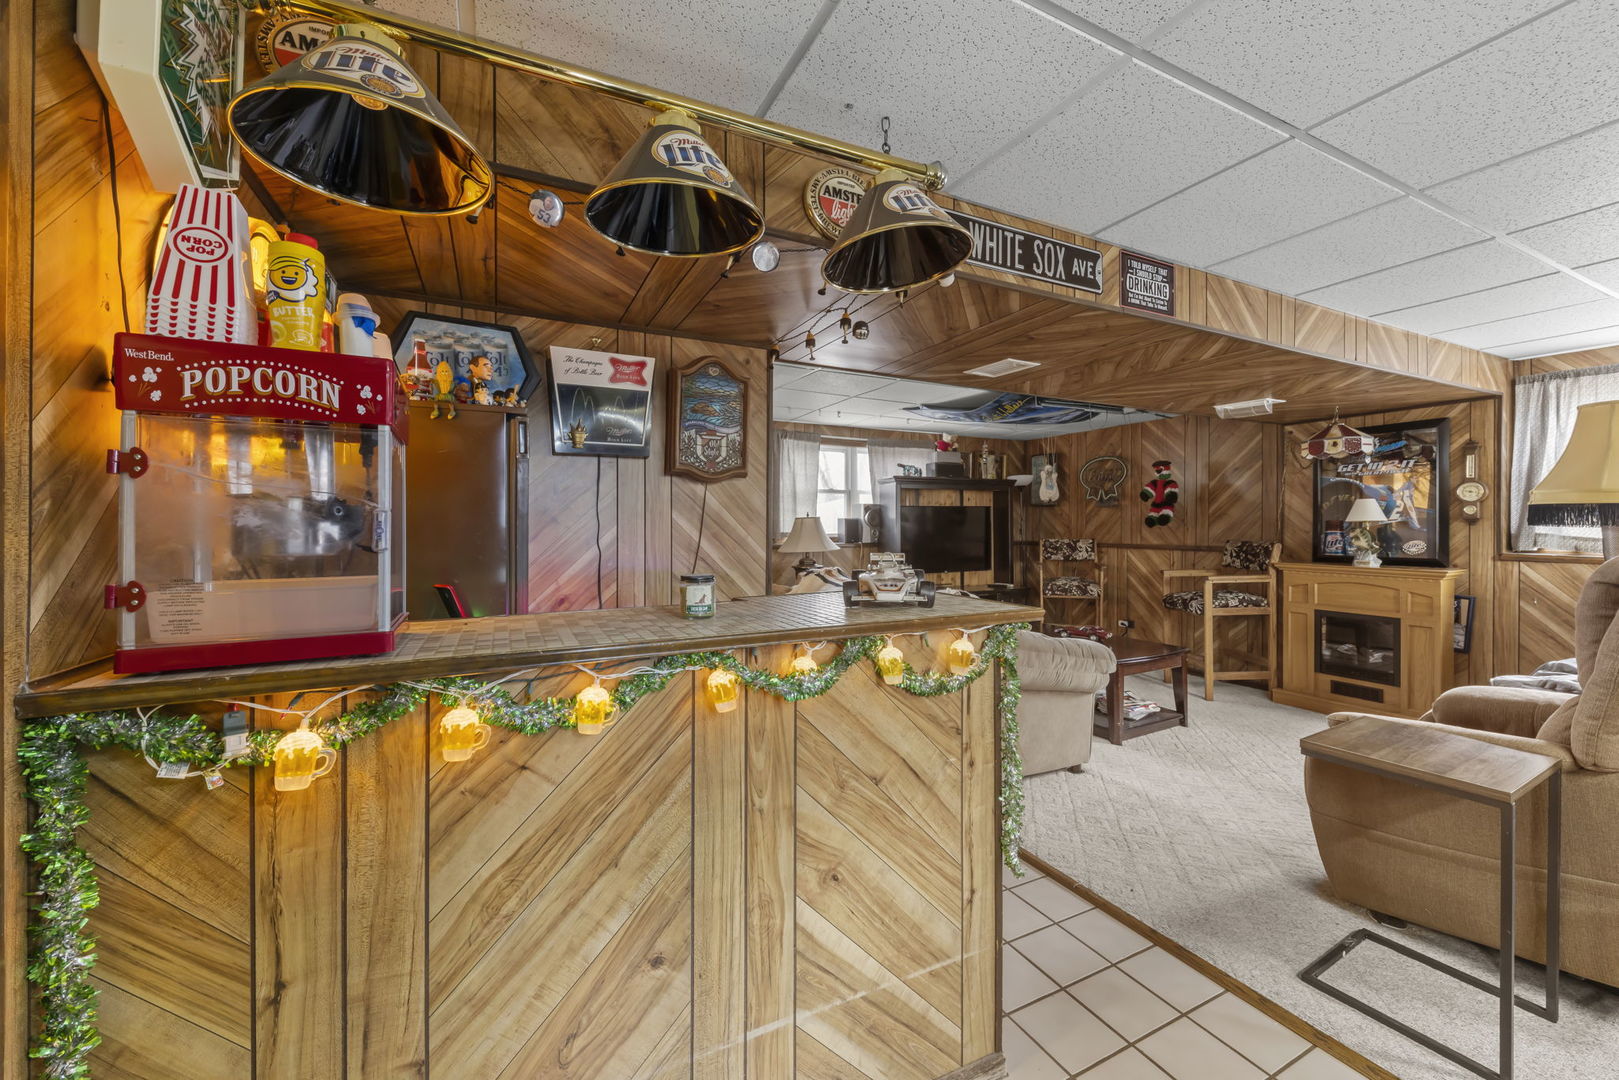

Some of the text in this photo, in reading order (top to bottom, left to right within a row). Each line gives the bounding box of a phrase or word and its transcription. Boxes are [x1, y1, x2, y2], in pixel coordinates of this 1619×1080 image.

[661, 143, 723, 171] Lite
[823, 185, 863, 205] AMSTE
[181, 234, 223, 249] CORN
[186, 243, 216, 256] POP
[969, 221, 1094, 280] WHITE SOX AVE
[1131, 260, 1141, 270] TOLD
[1142, 262, 1157, 273] MYSELF
[1158, 266, 1168, 276] THAT
[1136, 269, 1152, 280] SHOULD
[1153, 273, 1163, 282] STOP
[1128, 275, 1168, 299] DRINKING
[272, 305, 313, 317] BUTTER
[124, 348, 147, 359] West
[563, 355, 603, 367] The Champagne
[588, 368, 603, 376] Beer
[615, 364, 641, 373] Miller
[180, 366, 342, 411] POPCORN
[1338, 459, 1416, 473] GET IN 2 IT
